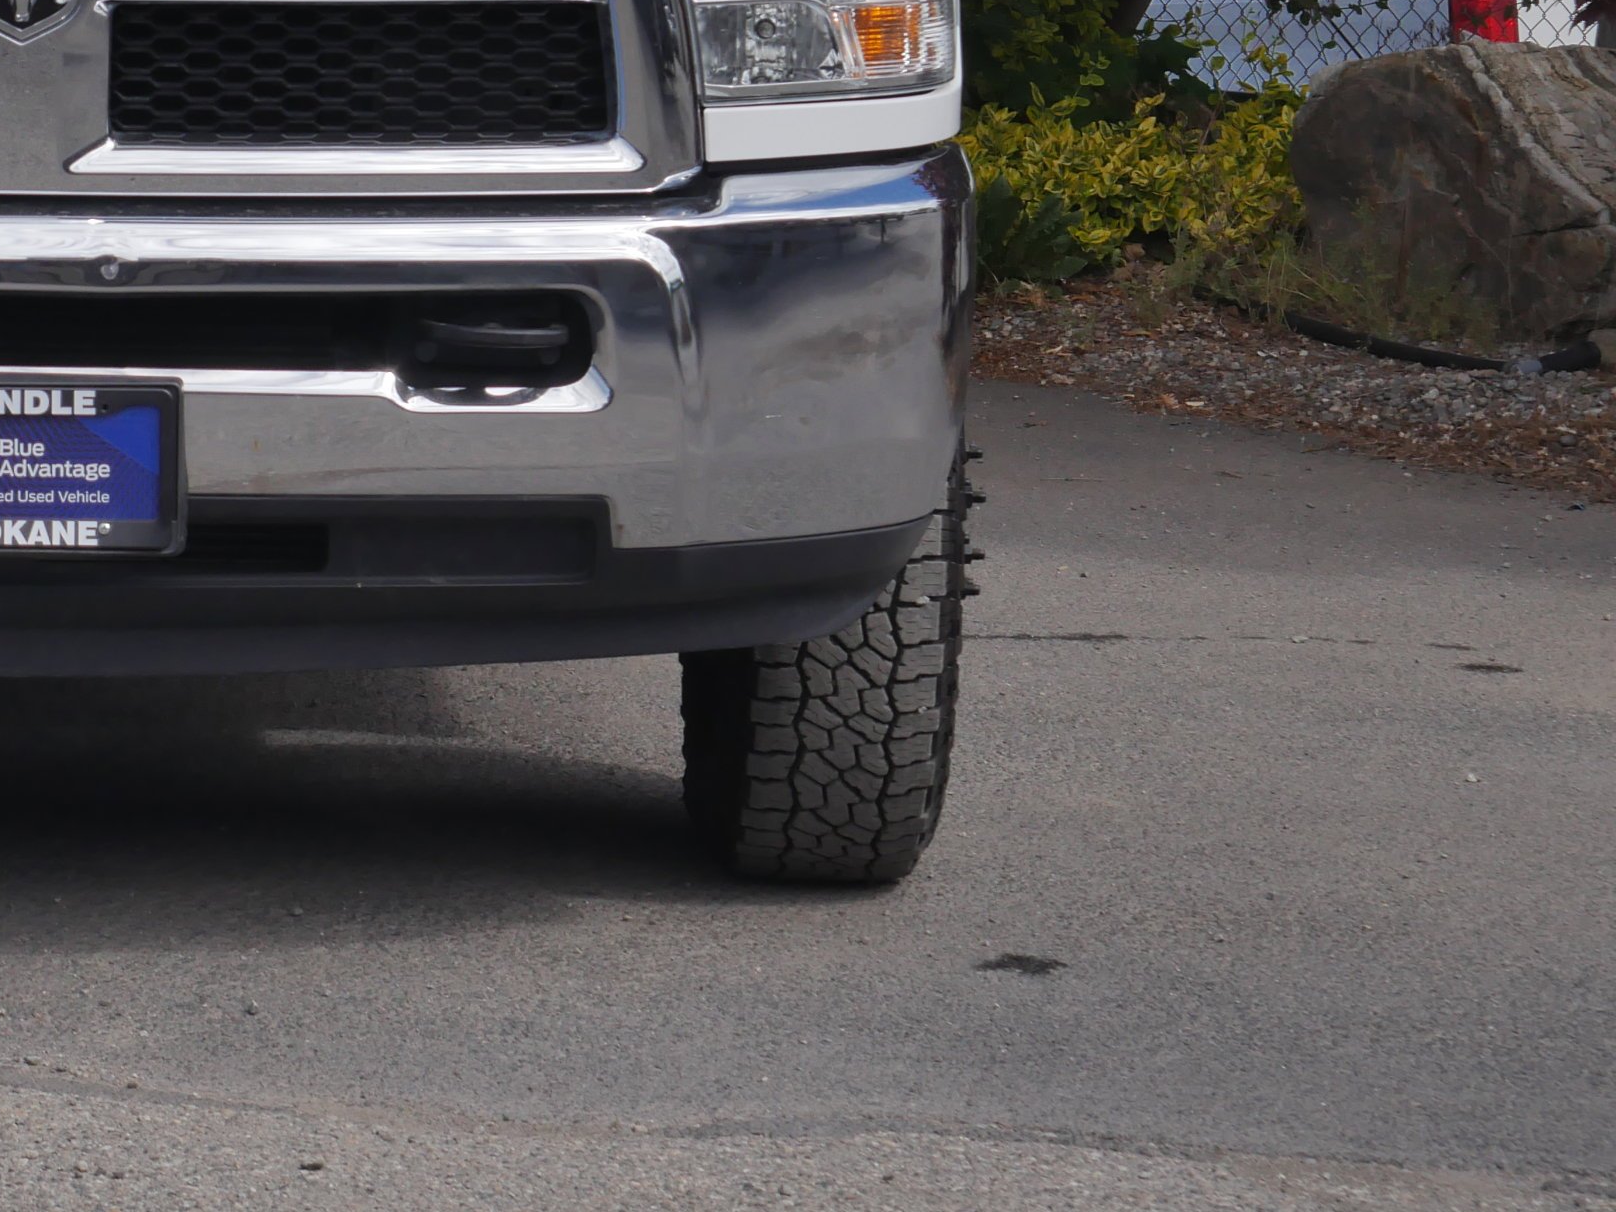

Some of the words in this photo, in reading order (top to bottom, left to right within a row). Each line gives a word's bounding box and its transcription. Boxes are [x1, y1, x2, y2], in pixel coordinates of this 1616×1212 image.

[0, 438, 45, 457] Blue
[17, 490, 55, 503] Used
[58, 491, 110, 504] Vehicle
